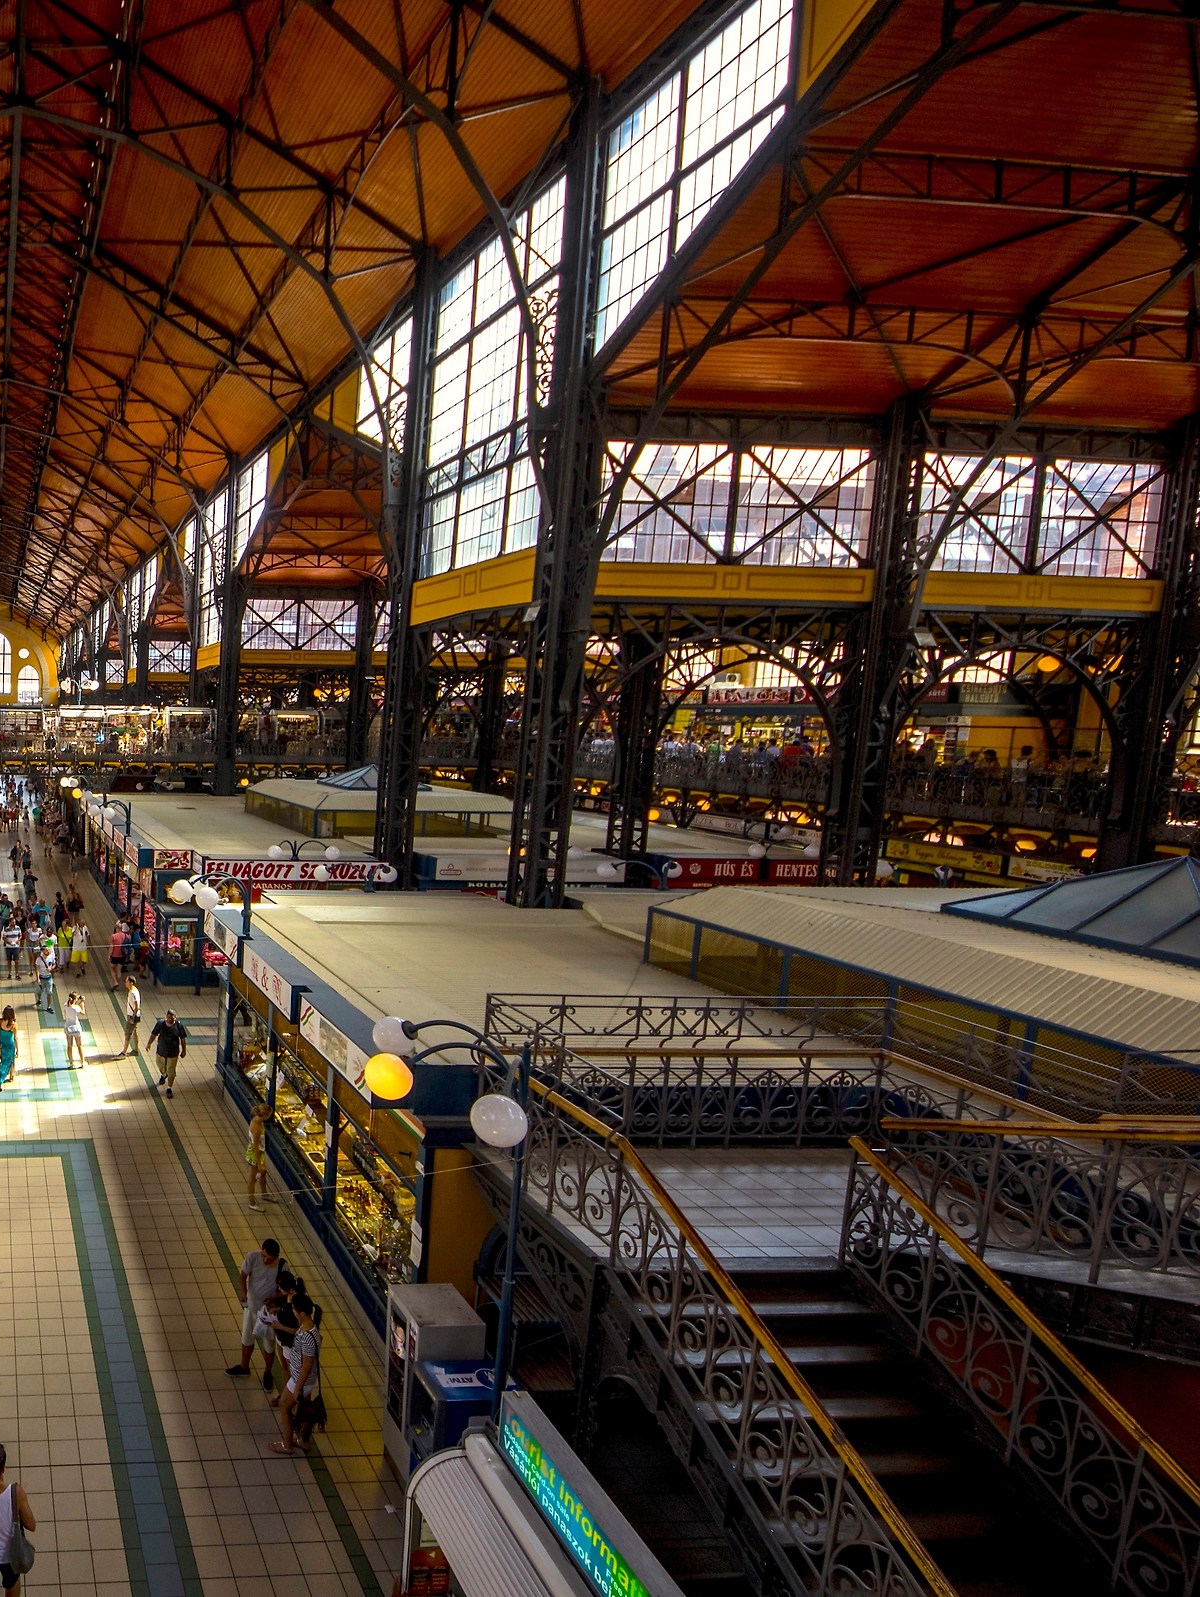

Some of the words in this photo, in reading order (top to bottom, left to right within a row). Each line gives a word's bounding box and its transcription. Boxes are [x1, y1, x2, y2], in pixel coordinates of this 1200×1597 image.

[714, 861, 735, 877] HÚS
[740, 862, 754, 877] ÉS
[504, 1423, 531, 1467] Budapest
[505, 1407, 556, 1489] Tourist
[504, 1433, 540, 1496] Vásárlói
[541, 1492, 592, 1571] panaszok
